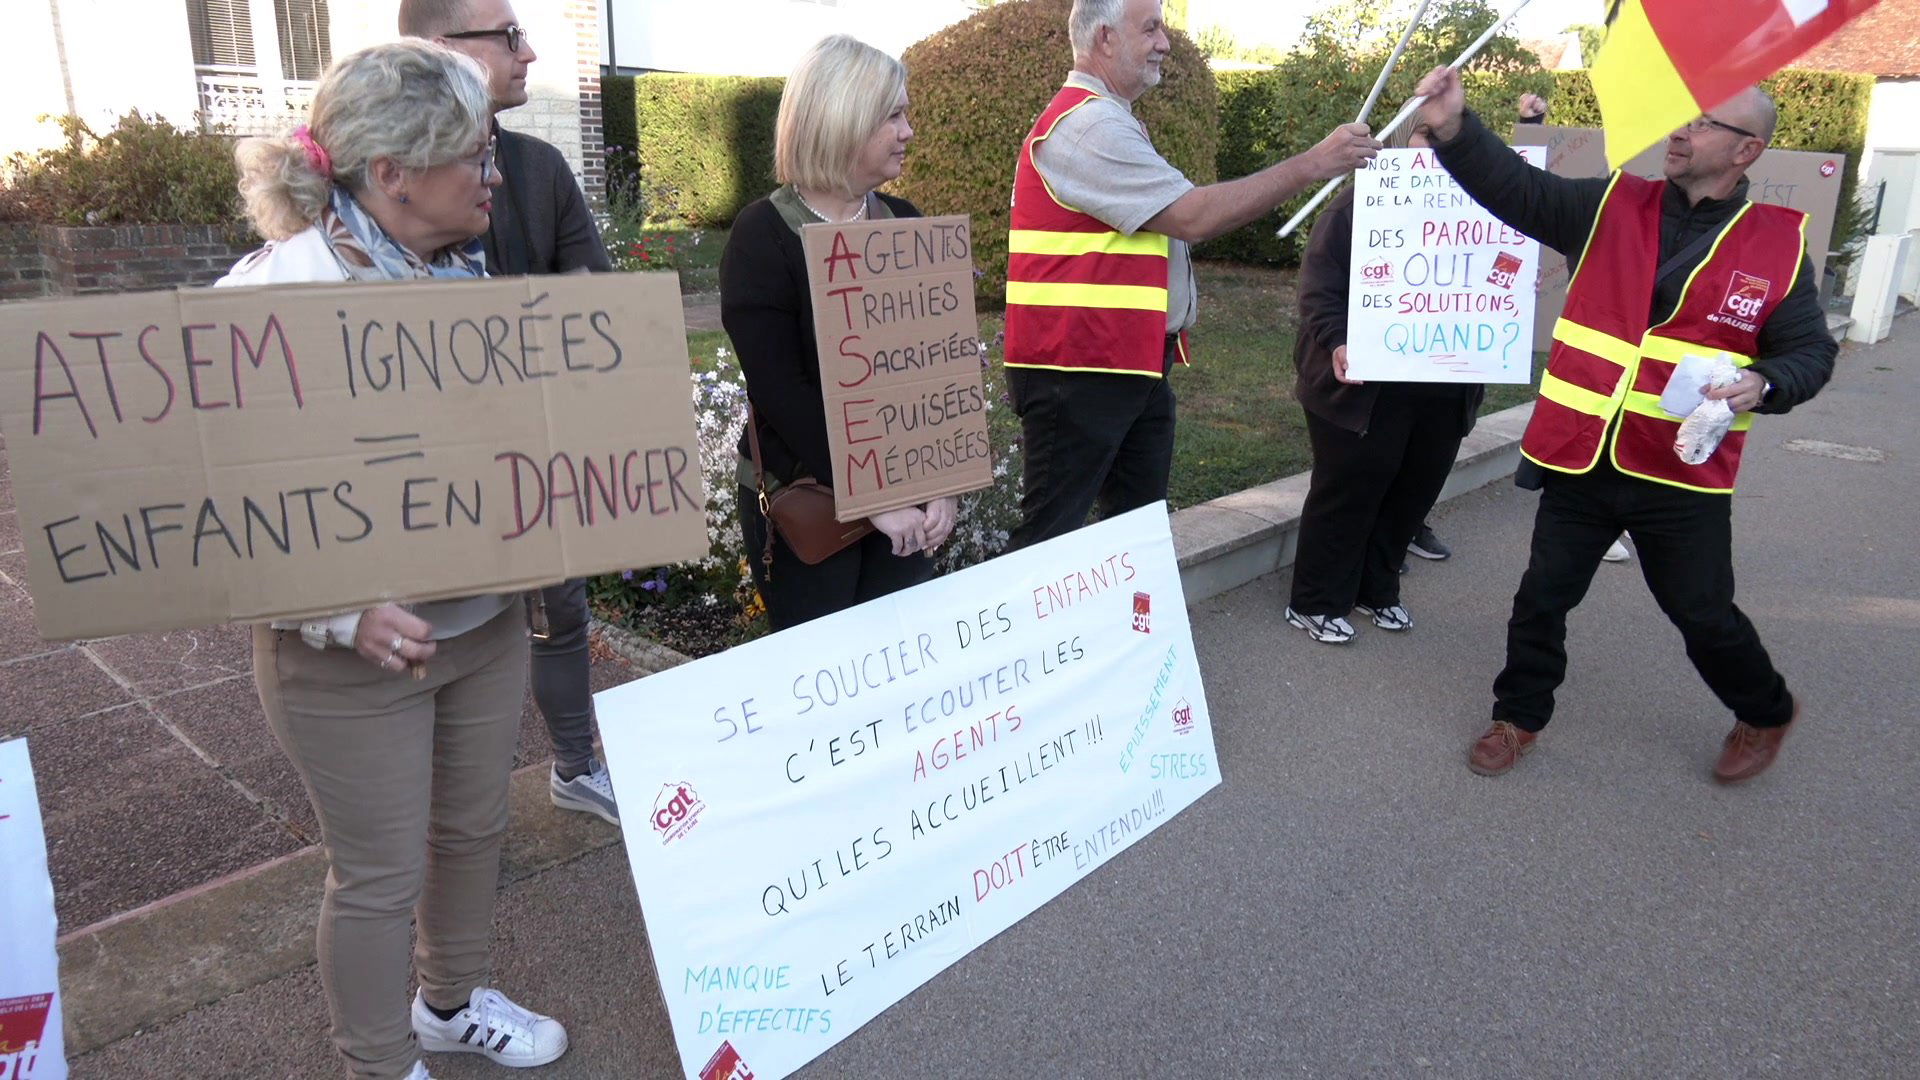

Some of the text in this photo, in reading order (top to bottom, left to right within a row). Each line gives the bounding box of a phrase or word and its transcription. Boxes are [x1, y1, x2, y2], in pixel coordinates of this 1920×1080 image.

[1368, 157, 1400, 171] NOS
[1379, 175, 1457, 188] NE DATE
[1367, 195, 1384, 207] DE
[1394, 195, 1412, 205] LA
[1369, 220, 1525, 248] DES PAROLES
[1363, 263, 1390, 279] cgt
[1404, 252, 1474, 288] OUI
[1488, 268, 1516, 286] cgt
[1362, 293, 1519, 317] DES SOLUTIONS,
[1728, 295, 1762, 317] cgt
[33, 313, 303, 438] ATSEM
[44, 446, 701, 583] ENFANTS EN DANGER
[1133, 612, 1151, 630] cgt
[713, 550, 1137, 743] SE SOUCIER DES ENFANTS
[786, 635, 1084, 784] C'EST ECOUTER LES
[1119, 644, 1177, 774] ÉPUISSEMENT
[1174, 705, 1191, 725] cgt
[912, 705, 1024, 782] AGENTS
[1150, 753, 1207, 779] STRESS
[656, 786, 694, 829] cgt
[762, 857, 829, 917] QUI
[836, 828, 892, 878] LES
[911, 729, 1077, 840] ACCUEILLENT
[821, 959, 853, 997] LE
[862, 895, 961, 970] TERRAIN
[972, 842, 1027, 903] DOIT
[1032, 830, 1070, 868] ÊTRE
[684, 964, 790, 994] MANQUE
[697, 1003, 832, 1034] D'EFFECTIFS
